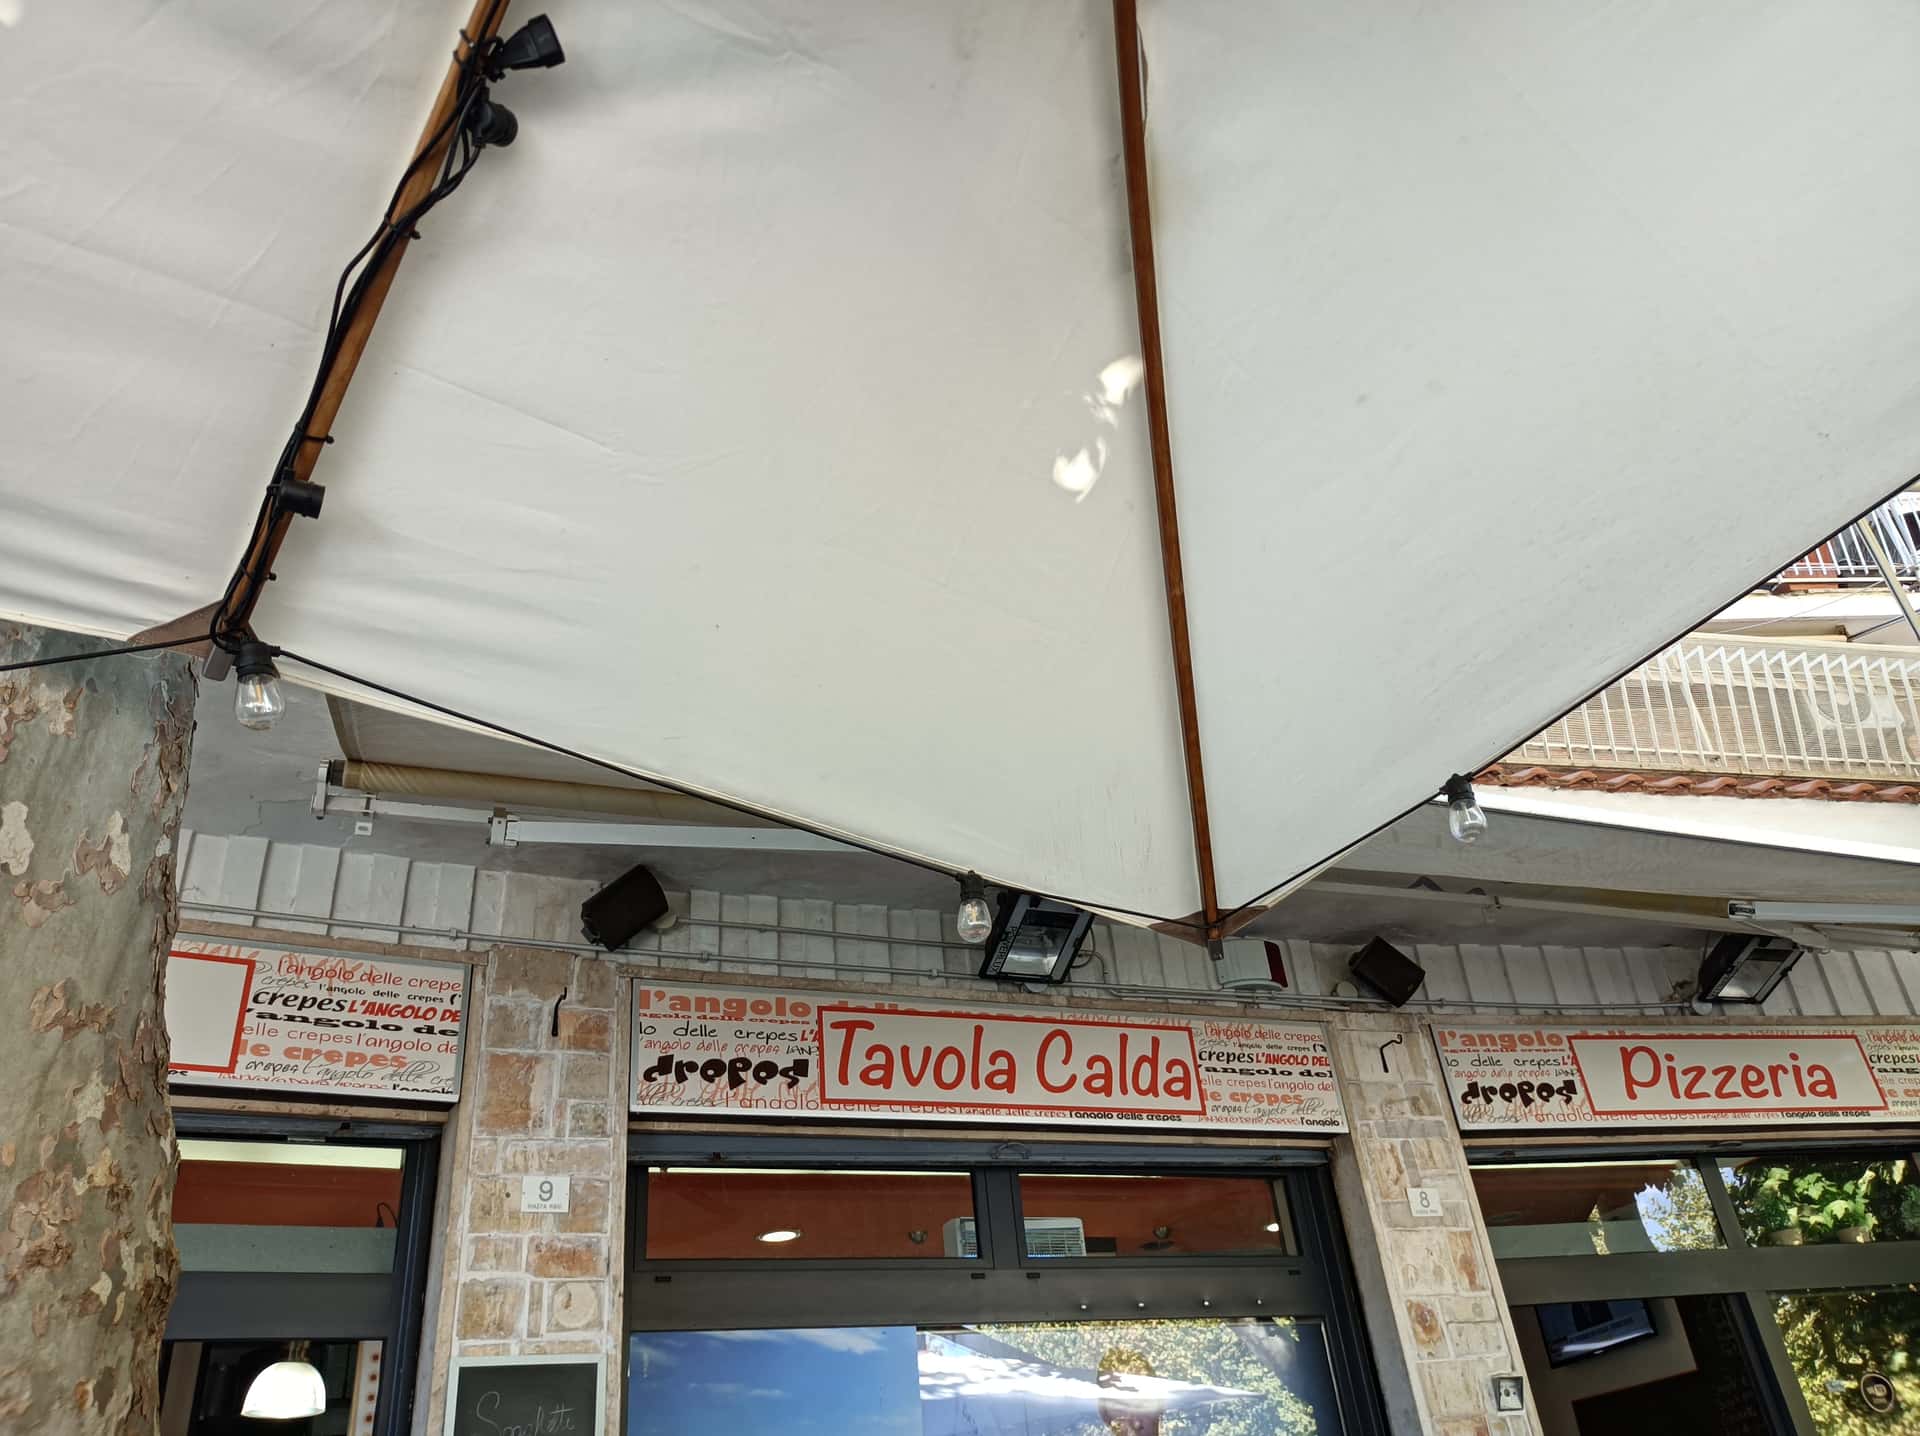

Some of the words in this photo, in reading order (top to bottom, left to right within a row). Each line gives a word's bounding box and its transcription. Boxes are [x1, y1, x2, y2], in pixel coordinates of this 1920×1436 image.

[360, 967, 403, 986] delle
[252, 989, 348, 1013] crepes
[347, 1000, 436, 1021] L'ANGOLO
[372, 989, 400, 999] delle
[407, 994, 444, 1004] crepes
[639, 989, 811, 1019] l'angolo
[287, 1029, 352, 1044] crepes
[357, 1033, 432, 1053] l'angolo
[673, 1021, 718, 1038] delle
[734, 1029, 798, 1045] crepes
[1438, 1030, 1563, 1050] l'angolo
[696, 1039, 728, 1052] delle
[283, 1045, 409, 1069] crepes
[830, 1020, 1016, 1094] Tavola
[1037, 1029, 1191, 1100] Calda
[1199, 1049, 1254, 1064] crepes
[1256, 1053, 1309, 1066] L'ANGOLO
[1471, 1053, 1503, 1066] delle
[1514, 1058, 1560, 1069] crepes
[1869, 1053, 1916, 1066] crepes
[1620, 1046, 1838, 1100] Pizzeria
[1227, 1079, 1266, 1089] crepes
[1268, 1079, 1314, 1093] l'angolo
[1229, 1091, 1304, 1106] crepes
[538, 1180, 553, 1201] 9
[1419, 1191, 1430, 1208] 8
